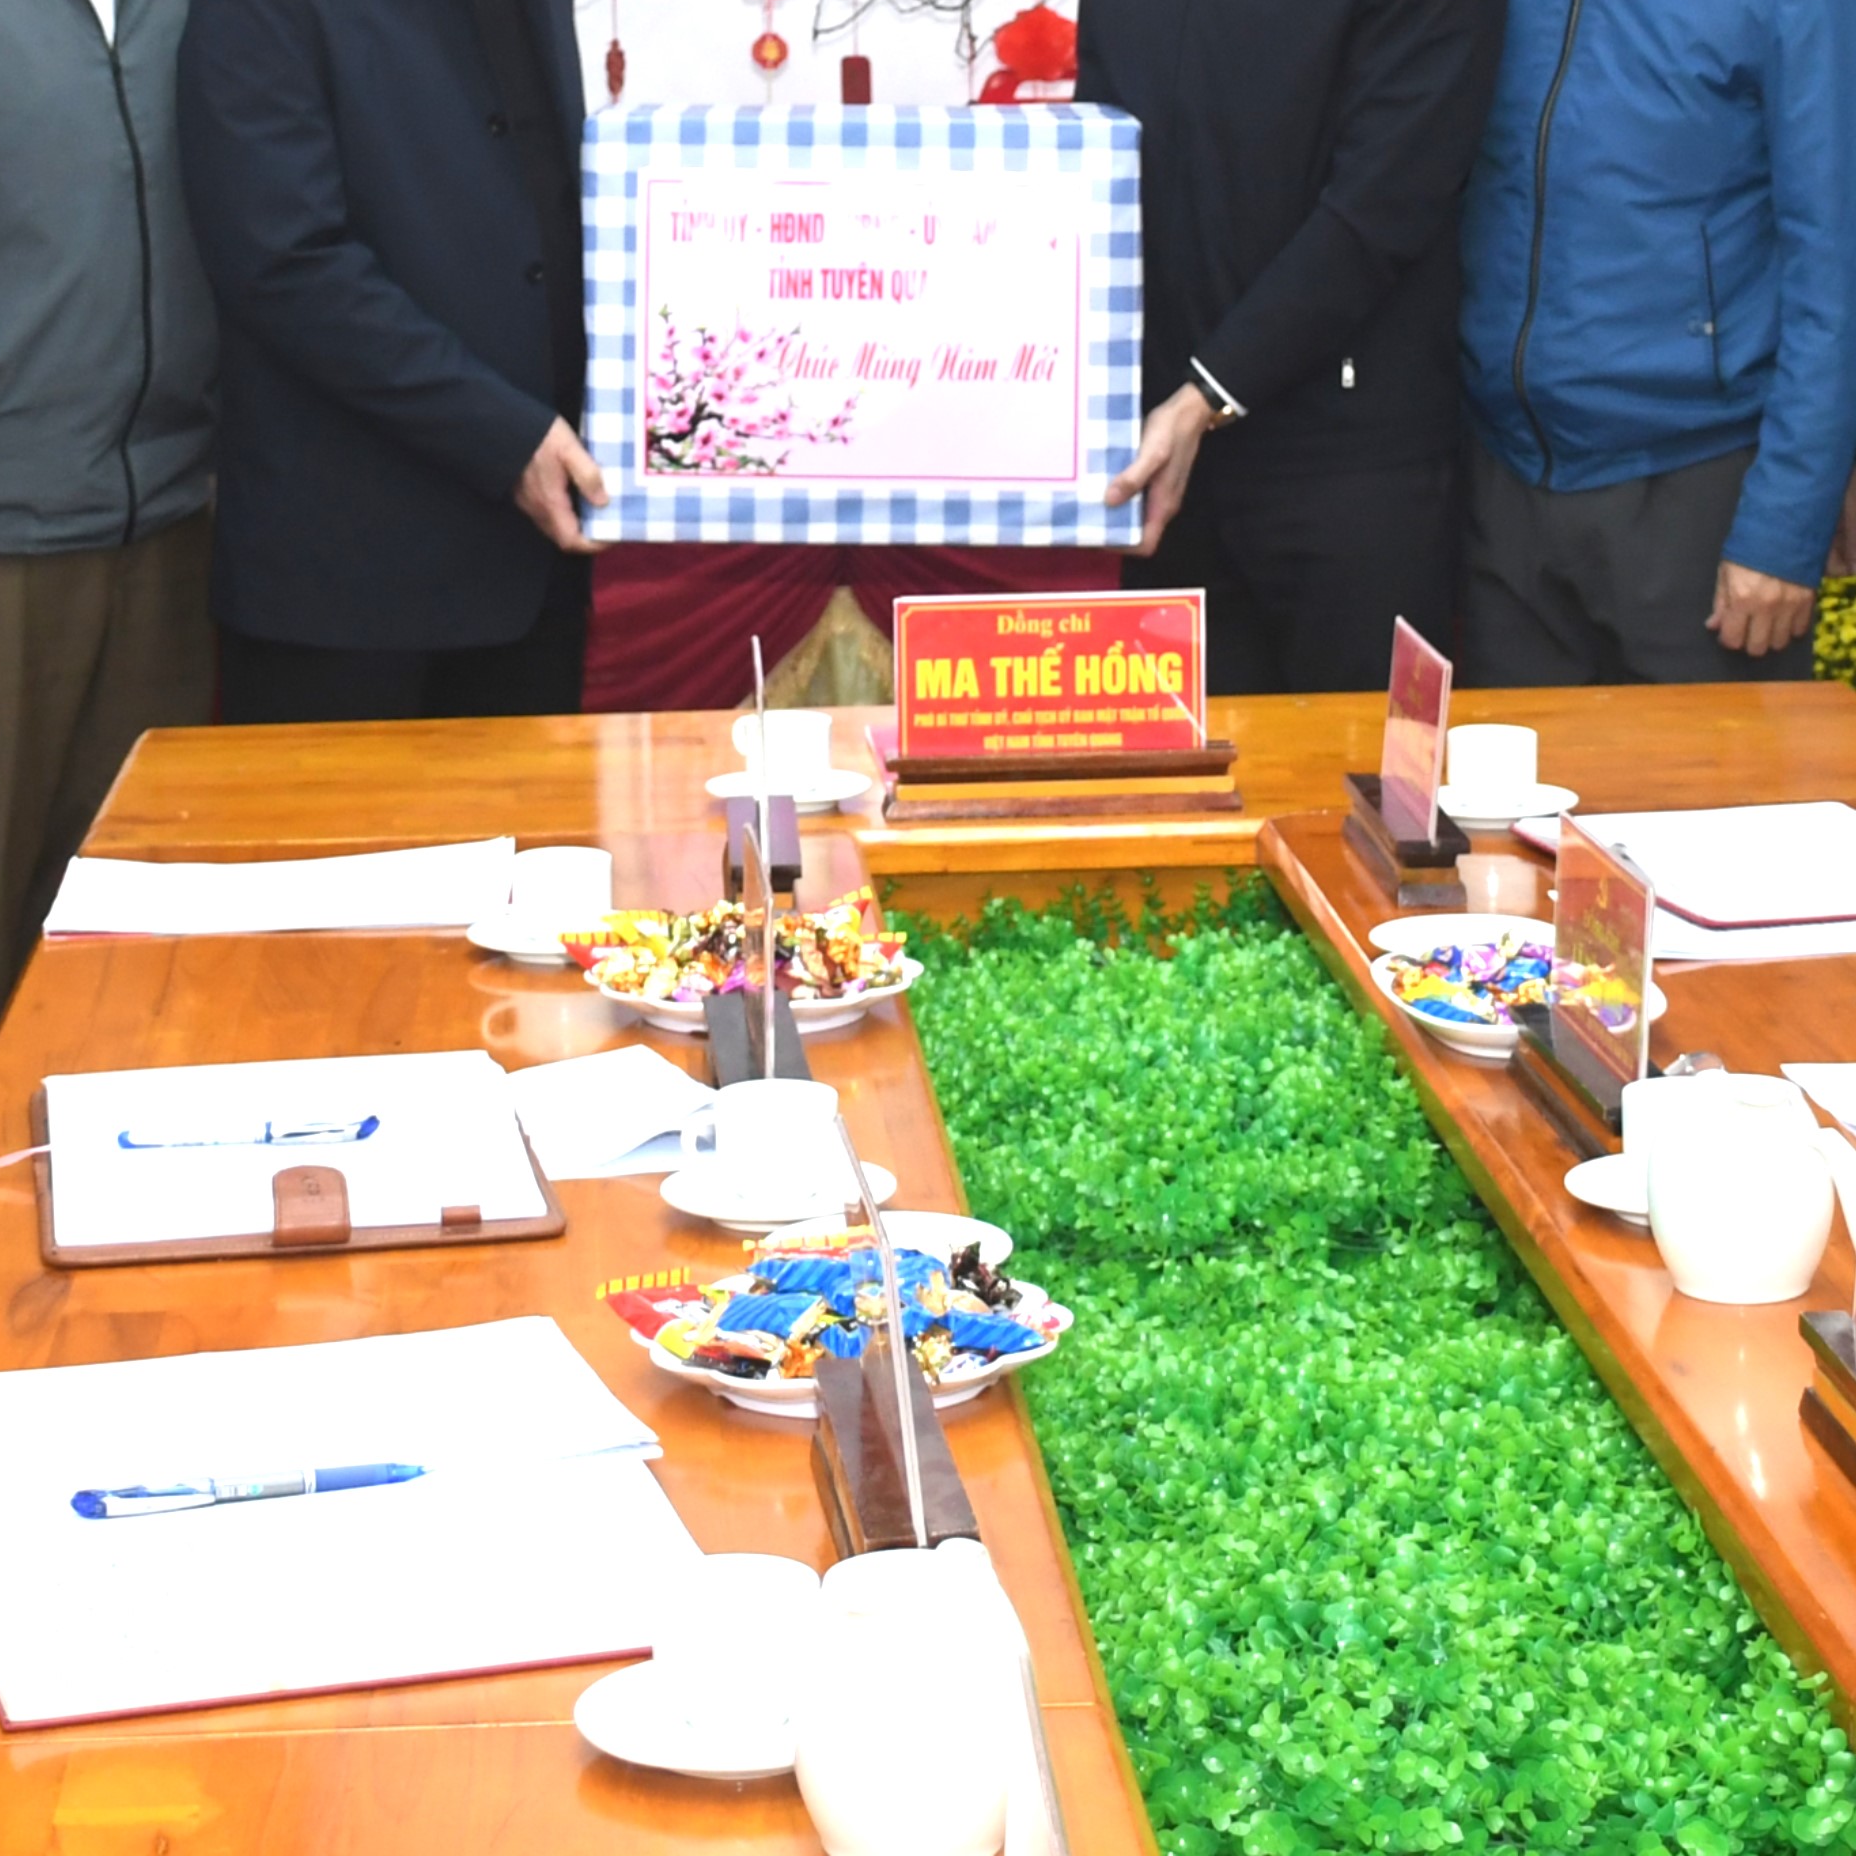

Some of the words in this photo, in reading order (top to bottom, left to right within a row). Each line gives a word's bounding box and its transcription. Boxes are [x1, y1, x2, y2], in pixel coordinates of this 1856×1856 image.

[770, 212, 825, 243] HĐND
[821, 261, 884, 300] TUYÊN
[996, 609, 1053, 637] Đồng
[1058, 612, 1091, 633] chí
[915, 657, 980, 700] MA
[990, 642, 1062, 698] THẾ
